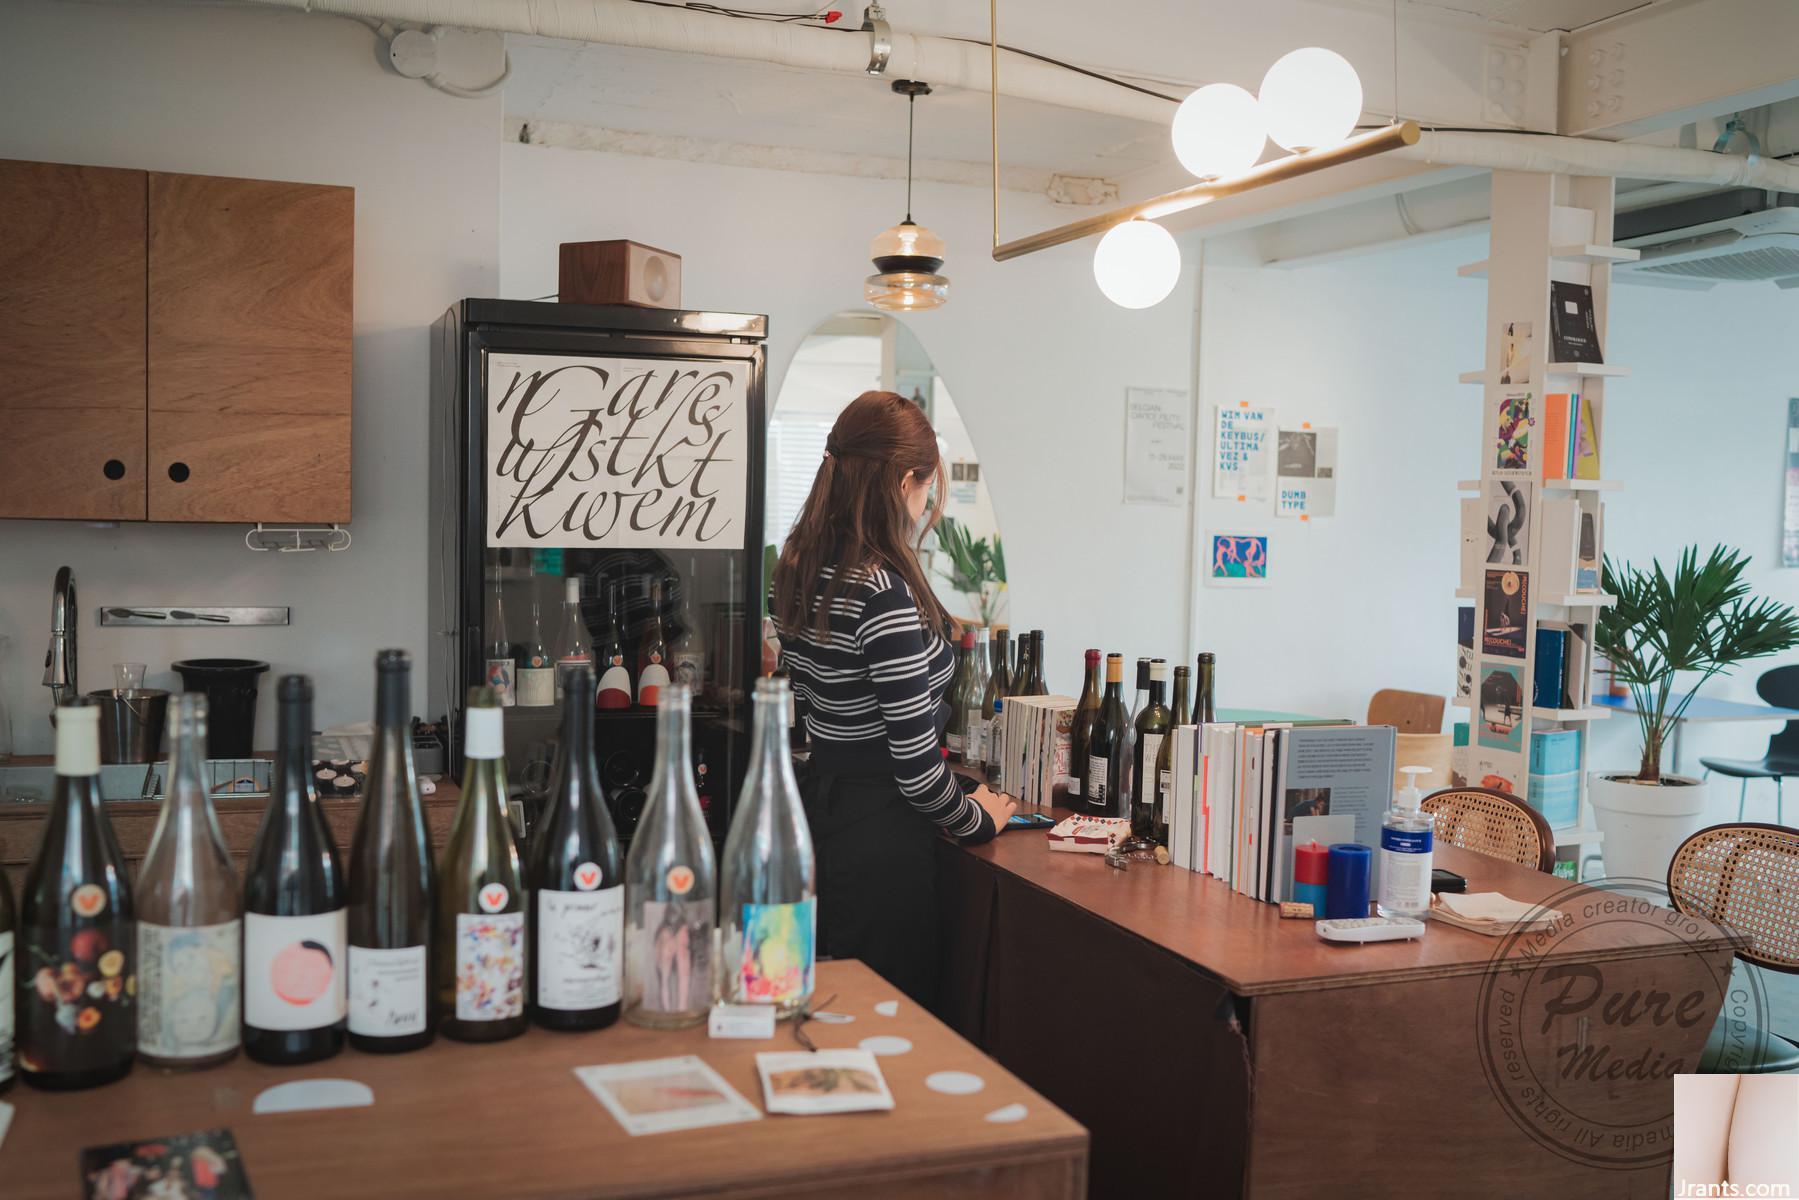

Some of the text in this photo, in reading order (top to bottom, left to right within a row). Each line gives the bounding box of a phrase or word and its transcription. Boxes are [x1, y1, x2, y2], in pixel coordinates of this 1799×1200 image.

[1221, 410, 1263, 420] WIM VAN
[1221, 420, 1232, 429] DE
[1220, 441, 1259, 451] ULTIMA
[1219, 461, 1238, 471] KVS
[1281, 490, 1306, 499] DUMB
[1282, 500, 1305, 510] TYPE
